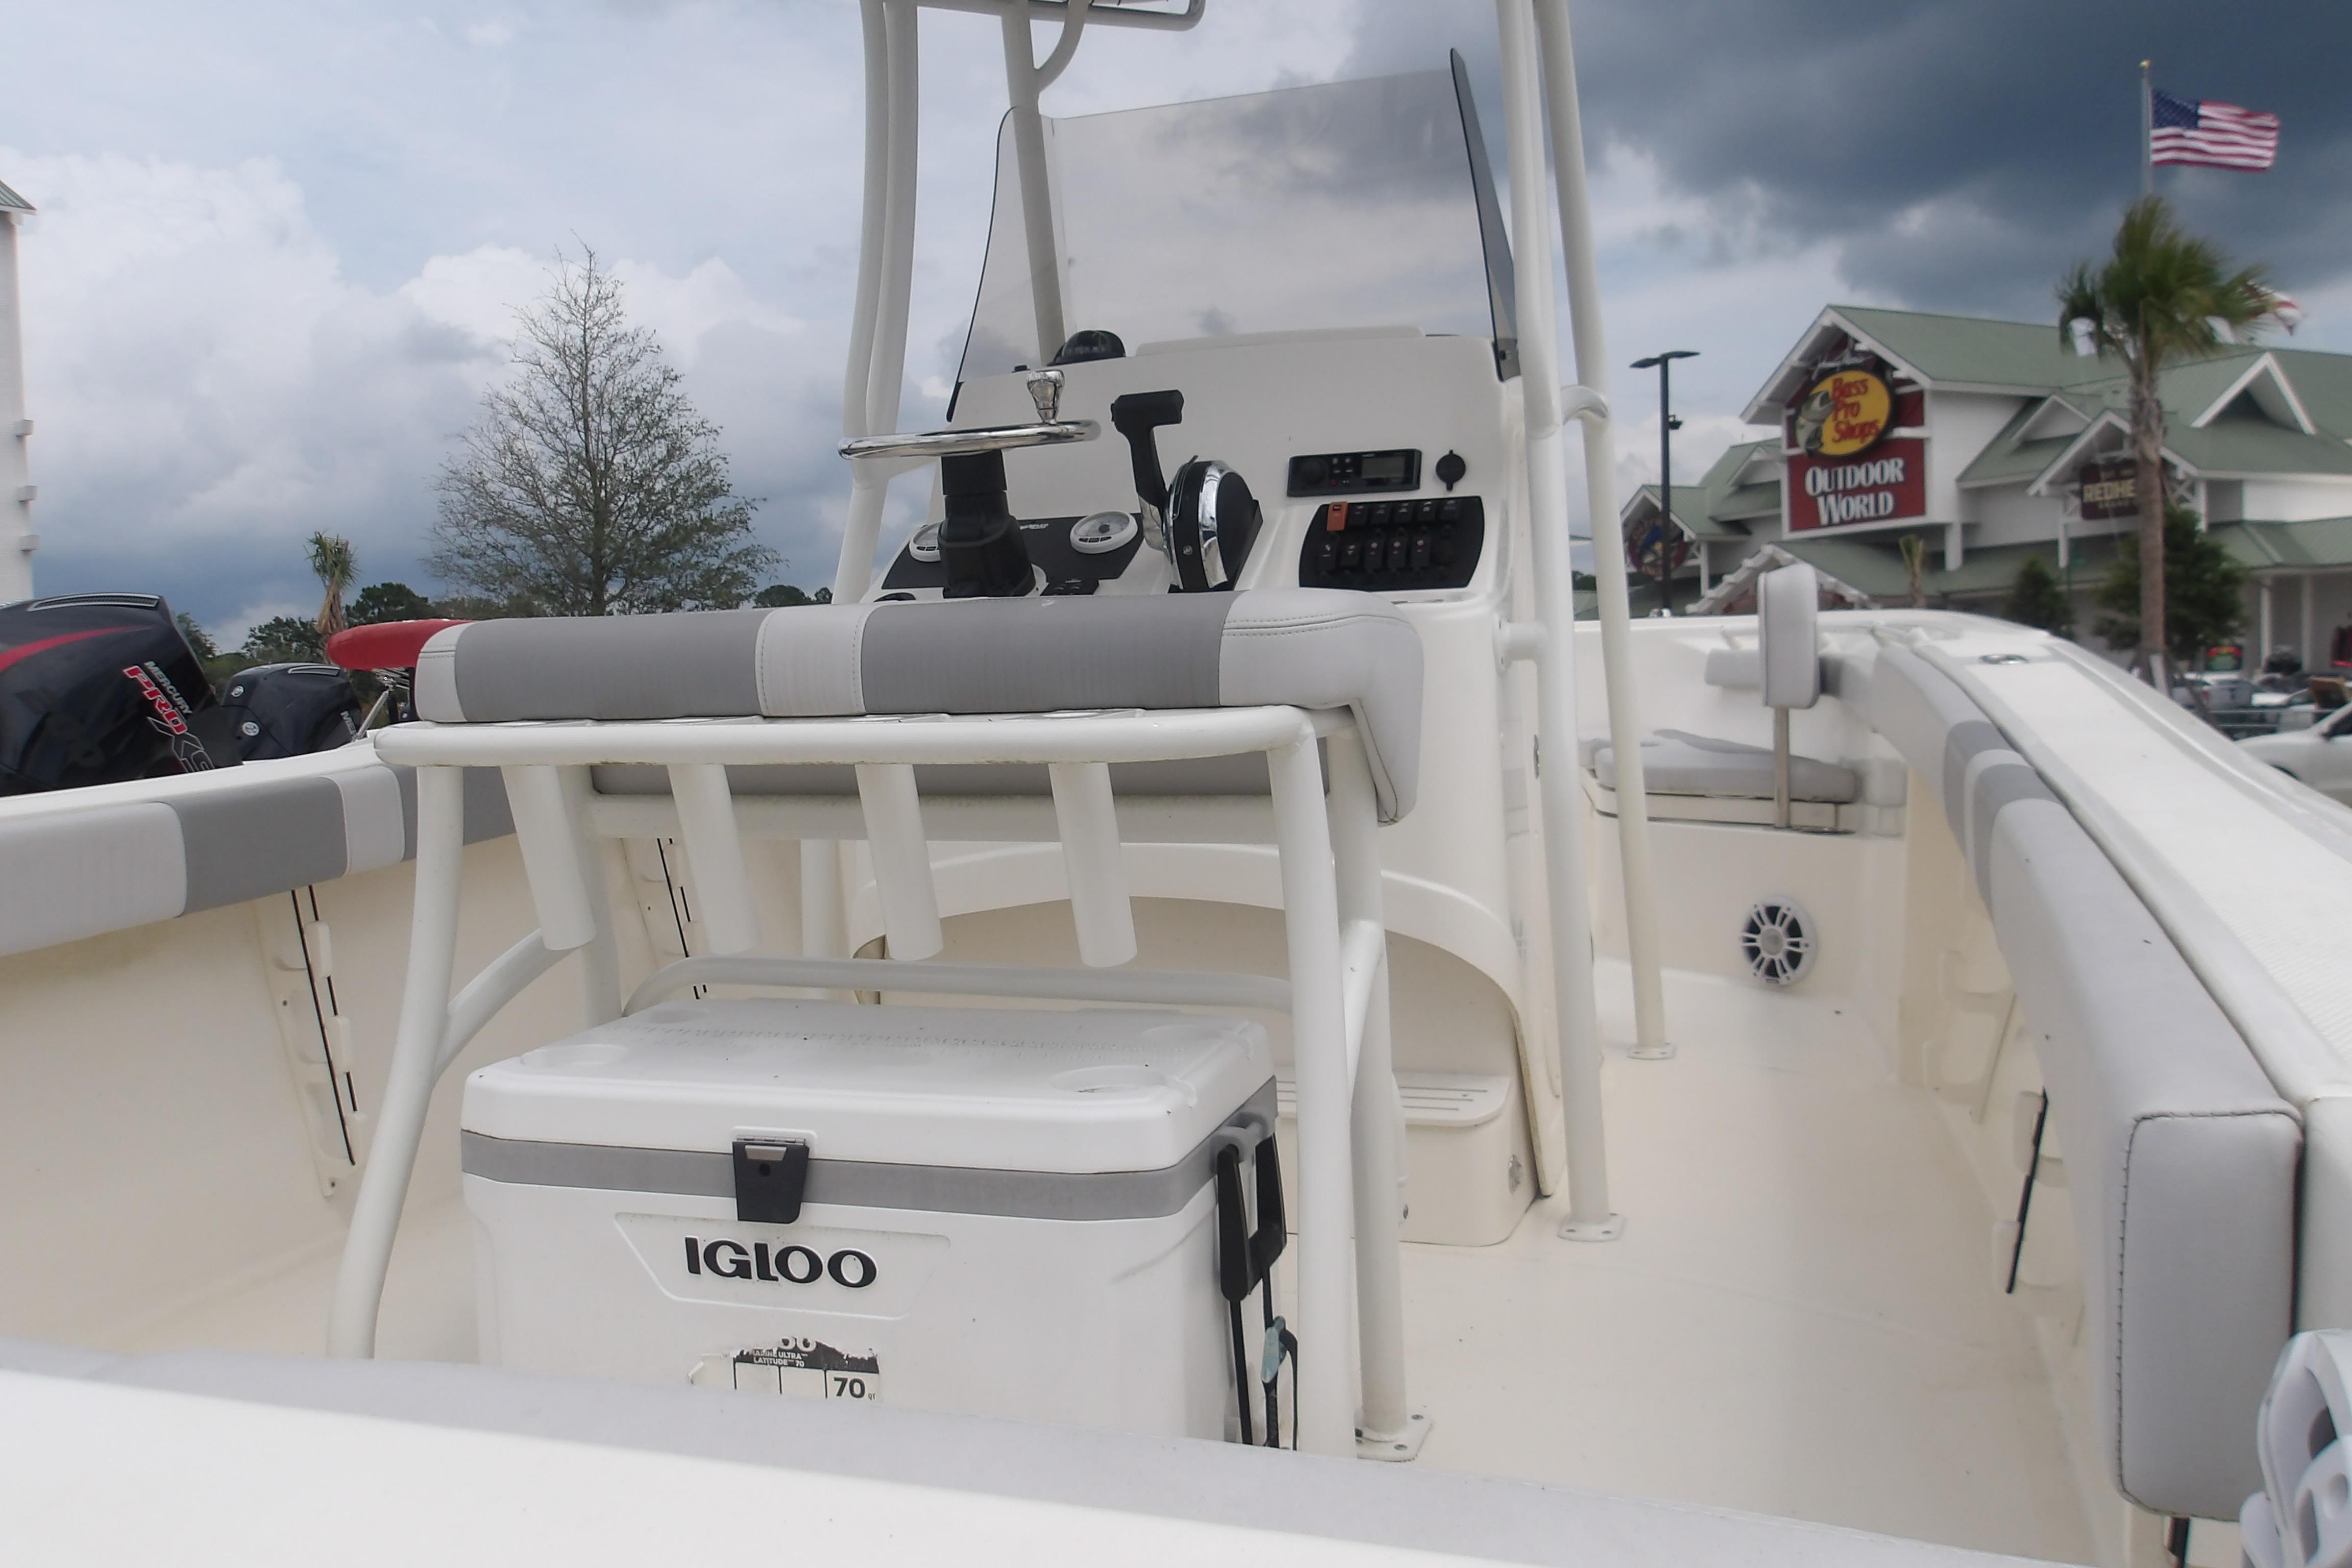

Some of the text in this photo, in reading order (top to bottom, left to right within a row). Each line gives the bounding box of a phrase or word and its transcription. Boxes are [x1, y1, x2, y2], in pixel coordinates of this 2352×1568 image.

[1831, 378, 1869, 400] Bass
[1831, 401, 1860, 423] Pro
[1832, 419, 1880, 444] Shops
[1805, 457, 1905, 497] OUTDOOR
[2082, 479, 2136, 503] REDHE
[1817, 490, 1893, 526] WORLD
[123, 666, 188, 735] PRO
[144, 661, 193, 715] MERCURY
[684, 1237, 877, 1288] IGLOO
[834, 1377, 866, 1399] 70
